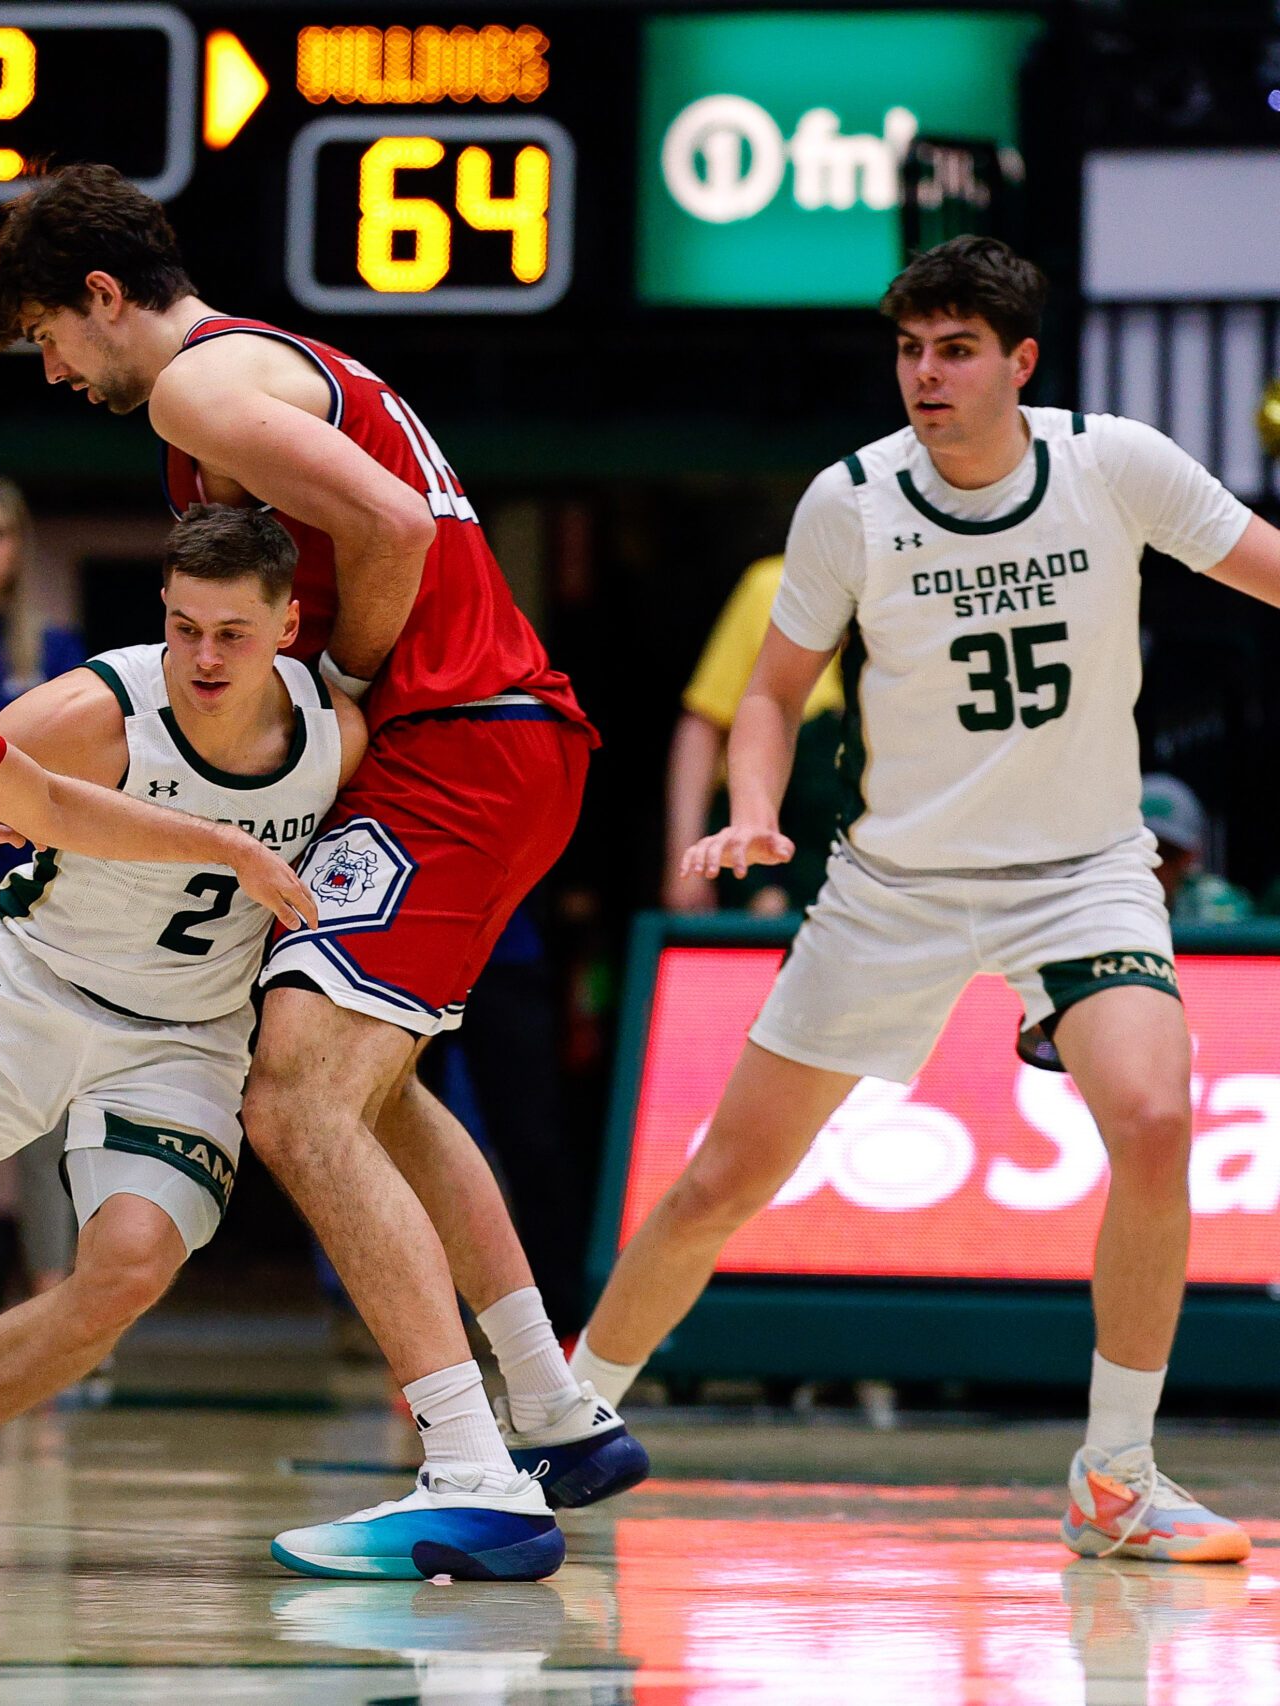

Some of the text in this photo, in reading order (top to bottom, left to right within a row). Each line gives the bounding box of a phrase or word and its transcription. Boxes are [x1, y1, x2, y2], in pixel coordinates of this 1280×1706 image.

[356, 135, 552, 294] 64
[912, 549, 1090, 597] COLORADO
[953, 583, 1057, 618] STATE
[950, 621, 1072, 732] 35
[156, 871, 240, 956] 2
[157, 1133, 236, 1206] RAM
